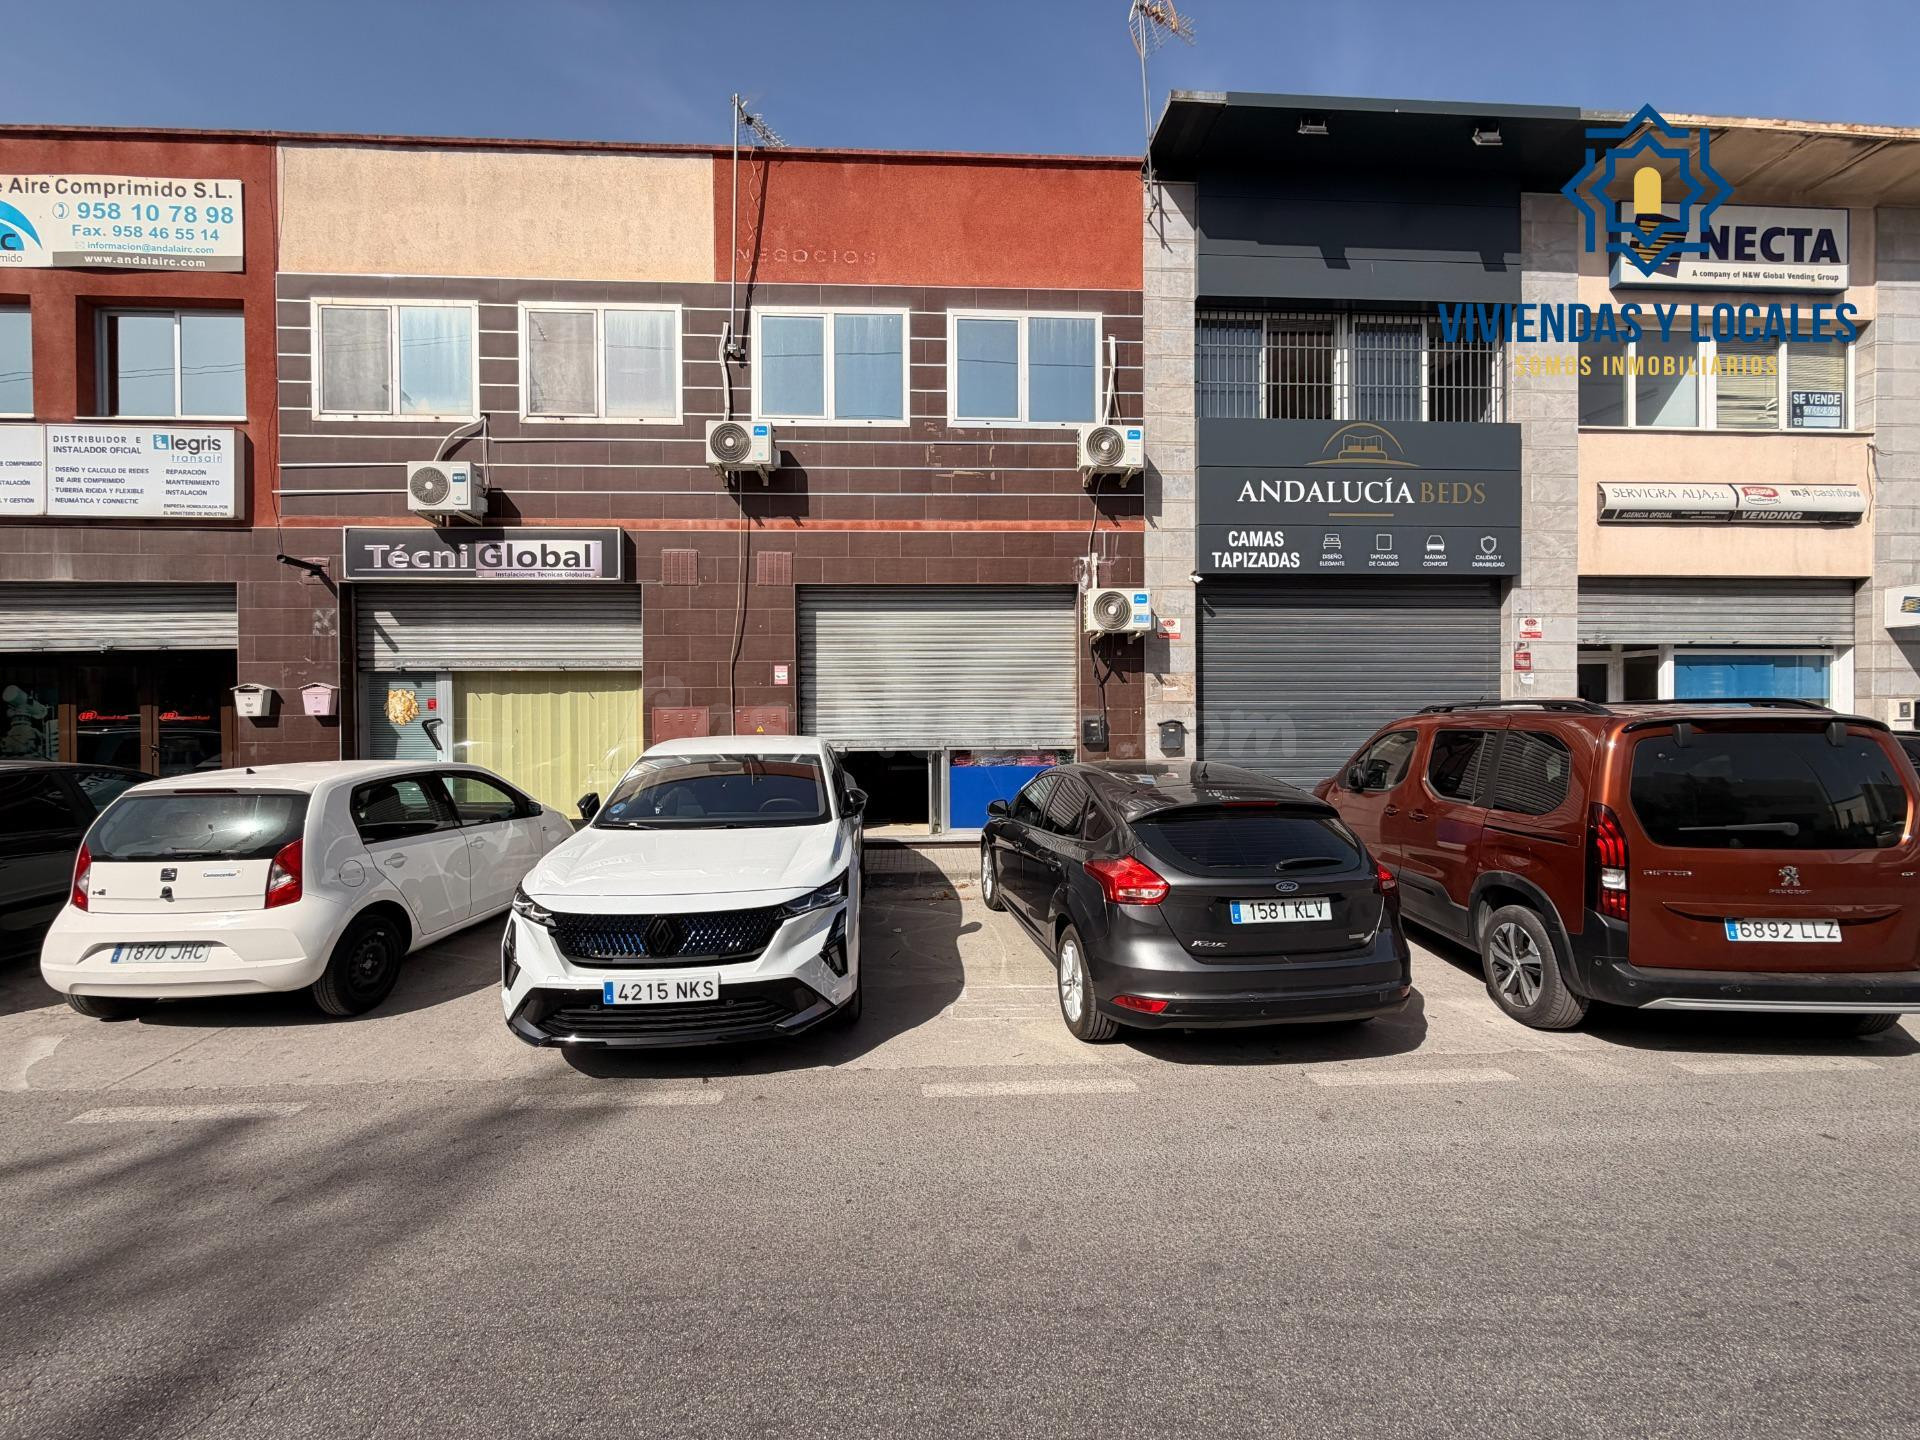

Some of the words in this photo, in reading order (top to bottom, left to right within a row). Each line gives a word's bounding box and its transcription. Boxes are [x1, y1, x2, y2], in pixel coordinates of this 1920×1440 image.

[8, 177, 50, 194] Aire
[55, 178, 187, 198] Comprimido
[193, 181, 233, 198] S.L.
[77, 202, 121, 219] 958
[131, 203, 160, 221] 10
[168, 205, 198, 223] 78
[205, 207, 234, 224] 98
[72, 224, 106, 236] Fax.
[112, 225, 143, 237] 958
[149, 227, 169, 239] 46
[175, 228, 195, 240] 55
[201, 229, 220, 241] 14
[1700, 225, 1841, 263] NECTA
[84, 255, 206, 267] www.andalairc.com
[736, 249, 876, 264] NEGOCIOS
[1692, 269, 1698, 277] A
[1700, 271, 1731, 280] company
[1787, 272, 1815, 282] Vending
[1817, 273, 1839, 282] Group
[1793, 393, 1806, 404] SE
[1808, 393, 1841, 405] VENDE
[53, 435, 127, 443] DISTRIBUIDOR
[170, 435, 222, 455] legris
[1237, 477, 1415, 504] ANDALUCÍA
[1420, 482, 1487, 505] BEDS
[1611, 487, 1677, 498] SERVIGRA
[1741, 511, 1803, 520] VENDING
[1228, 531, 1284, 547] CAMAS
[364, 543, 469, 568] Técni
[478, 543, 592, 568] Global
[1211, 552, 1300, 568] TAPIZADAS
[1250, 902, 1288, 921] 1581
[1295, 900, 1324, 919] KLV
[1740, 921, 1794, 939] 6892
[1801, 921, 1838, 939] LLZ
[125, 945, 167, 961] 1870
[171, 944, 206, 960] JHC
[618, 982, 669, 1001] 4215
[675, 980, 715, 999] NKS
